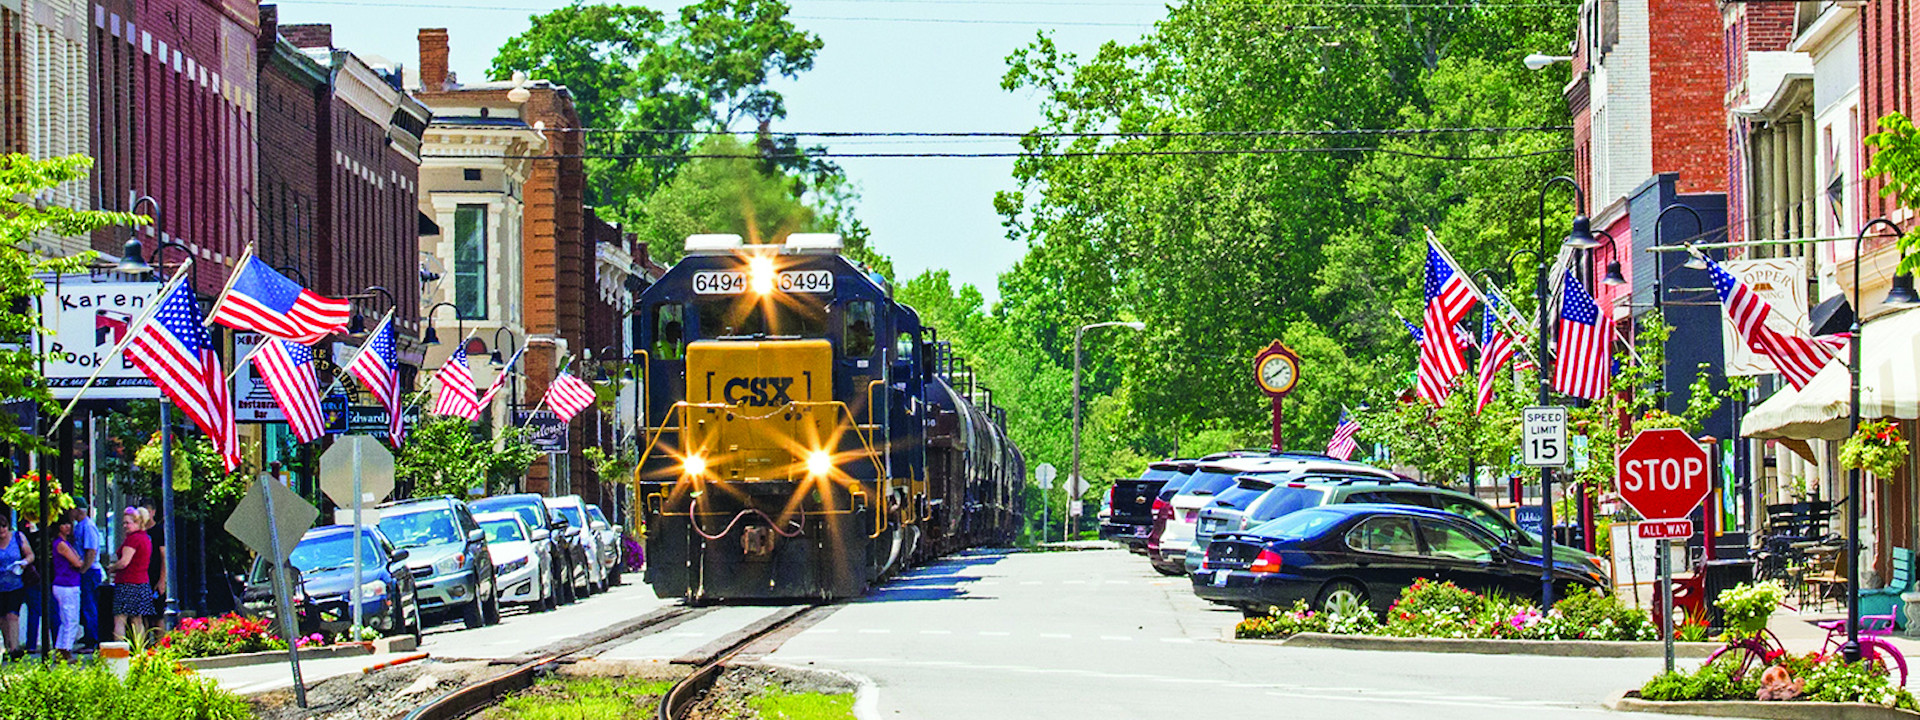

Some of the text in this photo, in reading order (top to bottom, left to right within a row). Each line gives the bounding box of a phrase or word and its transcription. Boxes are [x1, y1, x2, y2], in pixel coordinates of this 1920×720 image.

[696, 274, 744, 291] 6494
[780, 273, 830, 290] 6494
[1744, 270, 1791, 287] OPPER
[724, 376, 794, 407] CSX
[254, 410, 268, 418] Bar
[349, 411, 385, 423] Edward
[1527, 413, 1562, 422] SPEED
[1531, 426, 1558, 434] LIMIT
[1531, 439, 1558, 459] 15
[1625, 457, 1703, 492] STOP
[1643, 524, 1687, 536] ALL WAY
